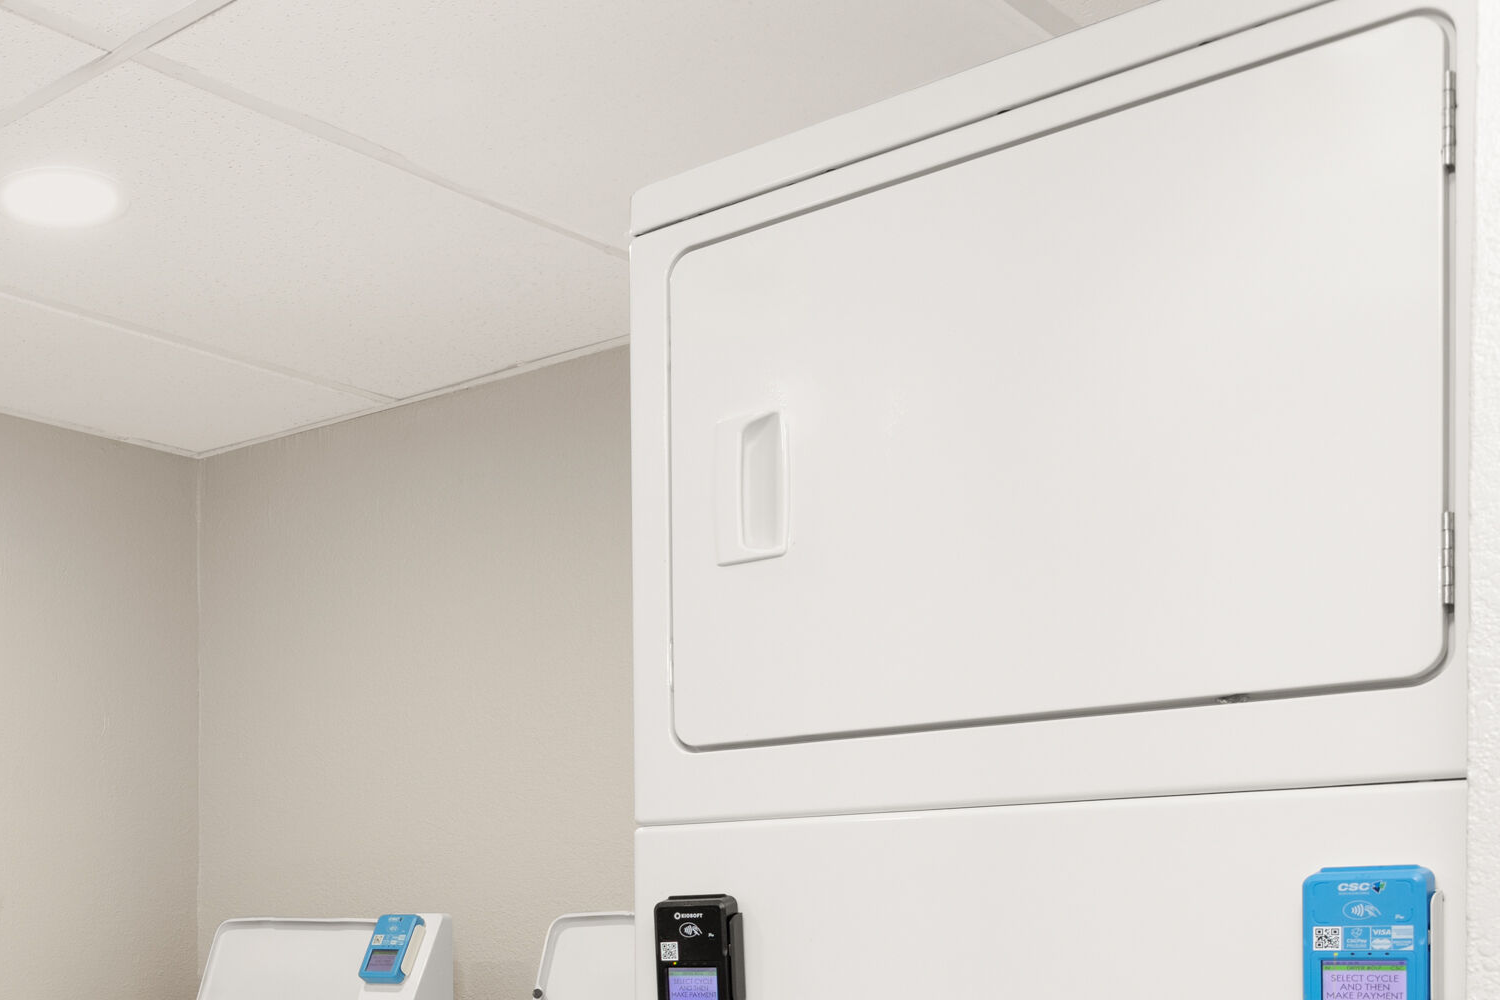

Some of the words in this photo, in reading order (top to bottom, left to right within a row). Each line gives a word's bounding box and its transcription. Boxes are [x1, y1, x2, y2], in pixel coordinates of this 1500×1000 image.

[1338, 883, 1370, 892] CSC
[1331, 974, 1364, 983] SELECT
[1367, 974, 1400, 983] CYCLE
[1340, 983, 1362, 991] AND
[1366, 983, 1391, 991] THEN
[1326, 992, 1354, 1000] MAKE
[1357, 992, 1404, 1000] PAYMENT
